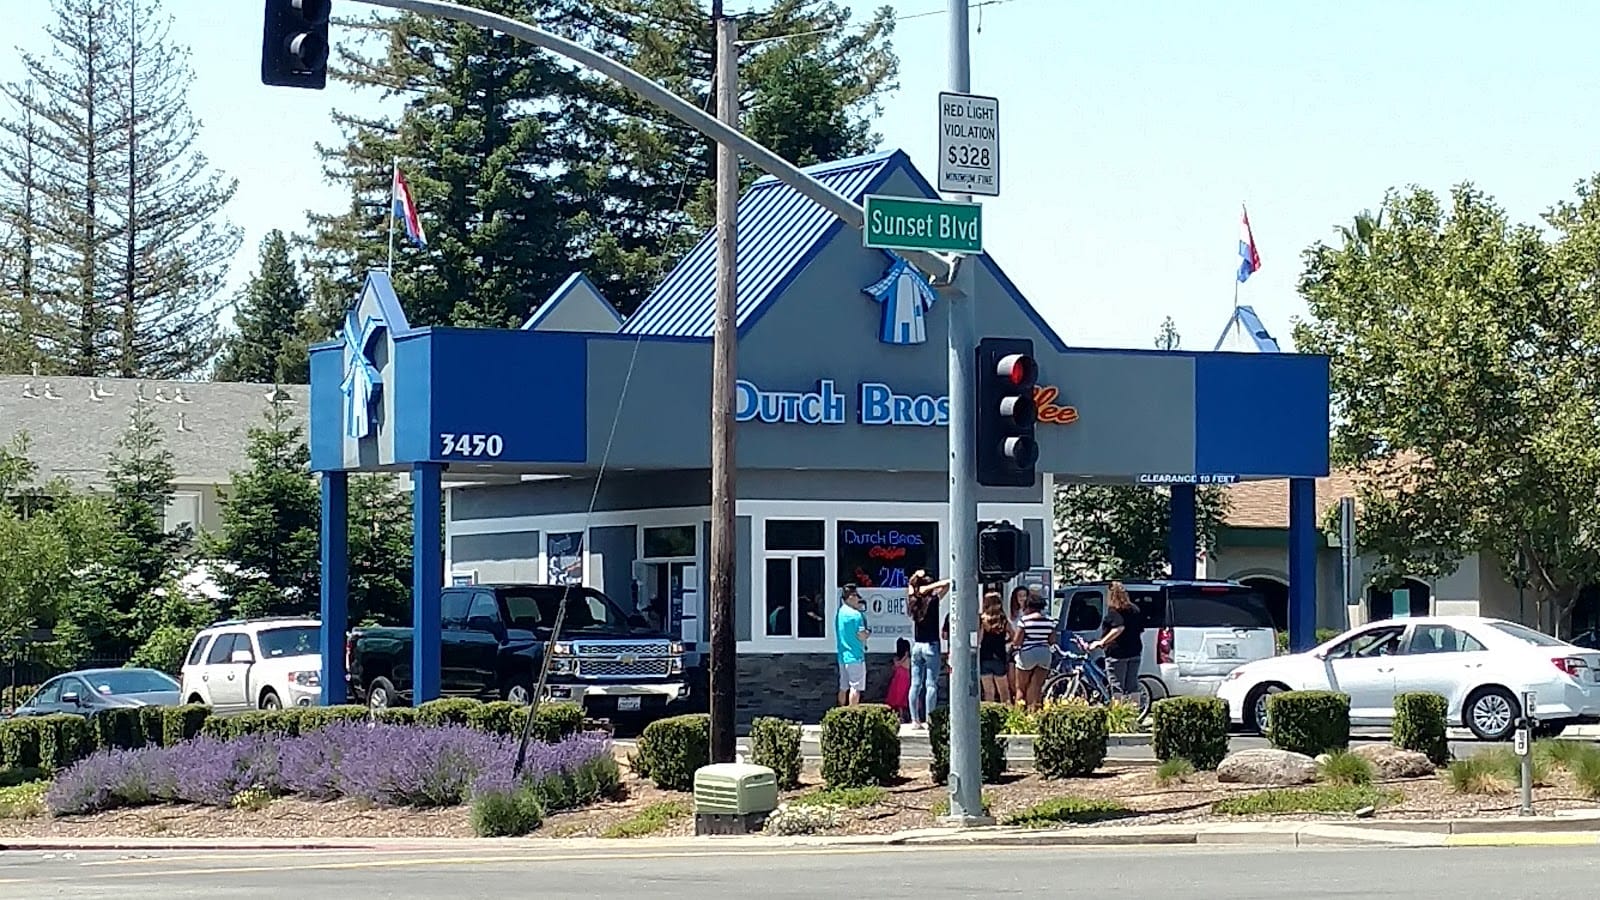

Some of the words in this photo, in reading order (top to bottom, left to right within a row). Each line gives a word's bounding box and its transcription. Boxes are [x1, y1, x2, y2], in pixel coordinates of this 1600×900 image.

[943, 102, 964, 117] RED
[967, 104, 994, 121] LIGHT
[944, 123, 995, 141] VIOLATION
[948, 144, 990, 167] $328
[977, 174, 993, 186] FINE
[872, 209, 934, 237] Sunset
[939, 214, 978, 241] Blvd
[440, 433, 503, 457] 3450
[1140, 474, 1197, 483] CLEARANCE
[1200, 474, 1210, 483] 10
[1212, 475, 1236, 484] FEET
